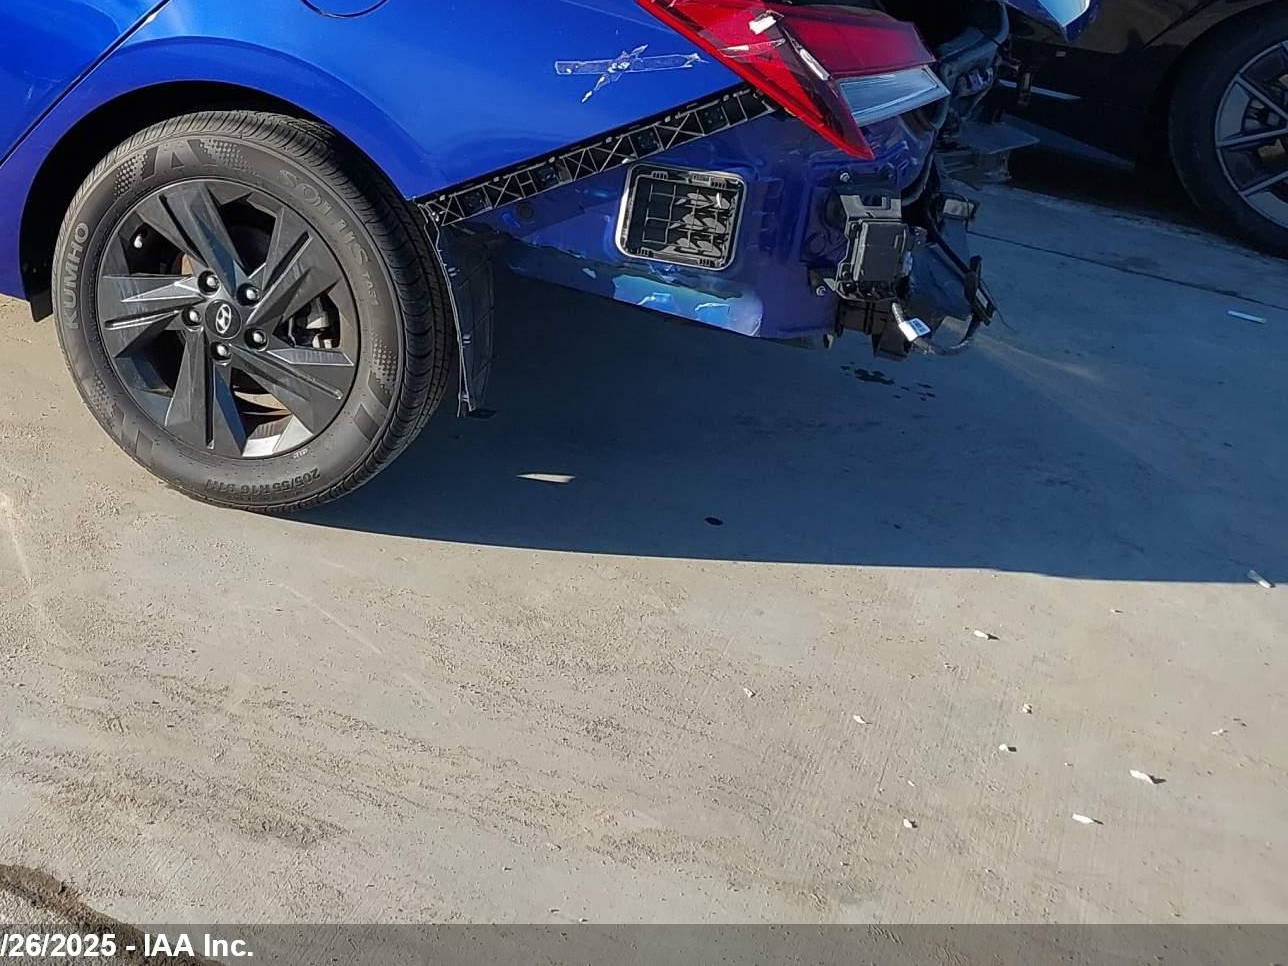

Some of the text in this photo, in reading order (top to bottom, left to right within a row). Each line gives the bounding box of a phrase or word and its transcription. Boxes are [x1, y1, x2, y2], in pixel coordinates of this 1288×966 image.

[279, 170, 369, 265] SOLUS
[63, 222, 89, 330] KUMHO
[272, 467, 321, 492] 205/55
